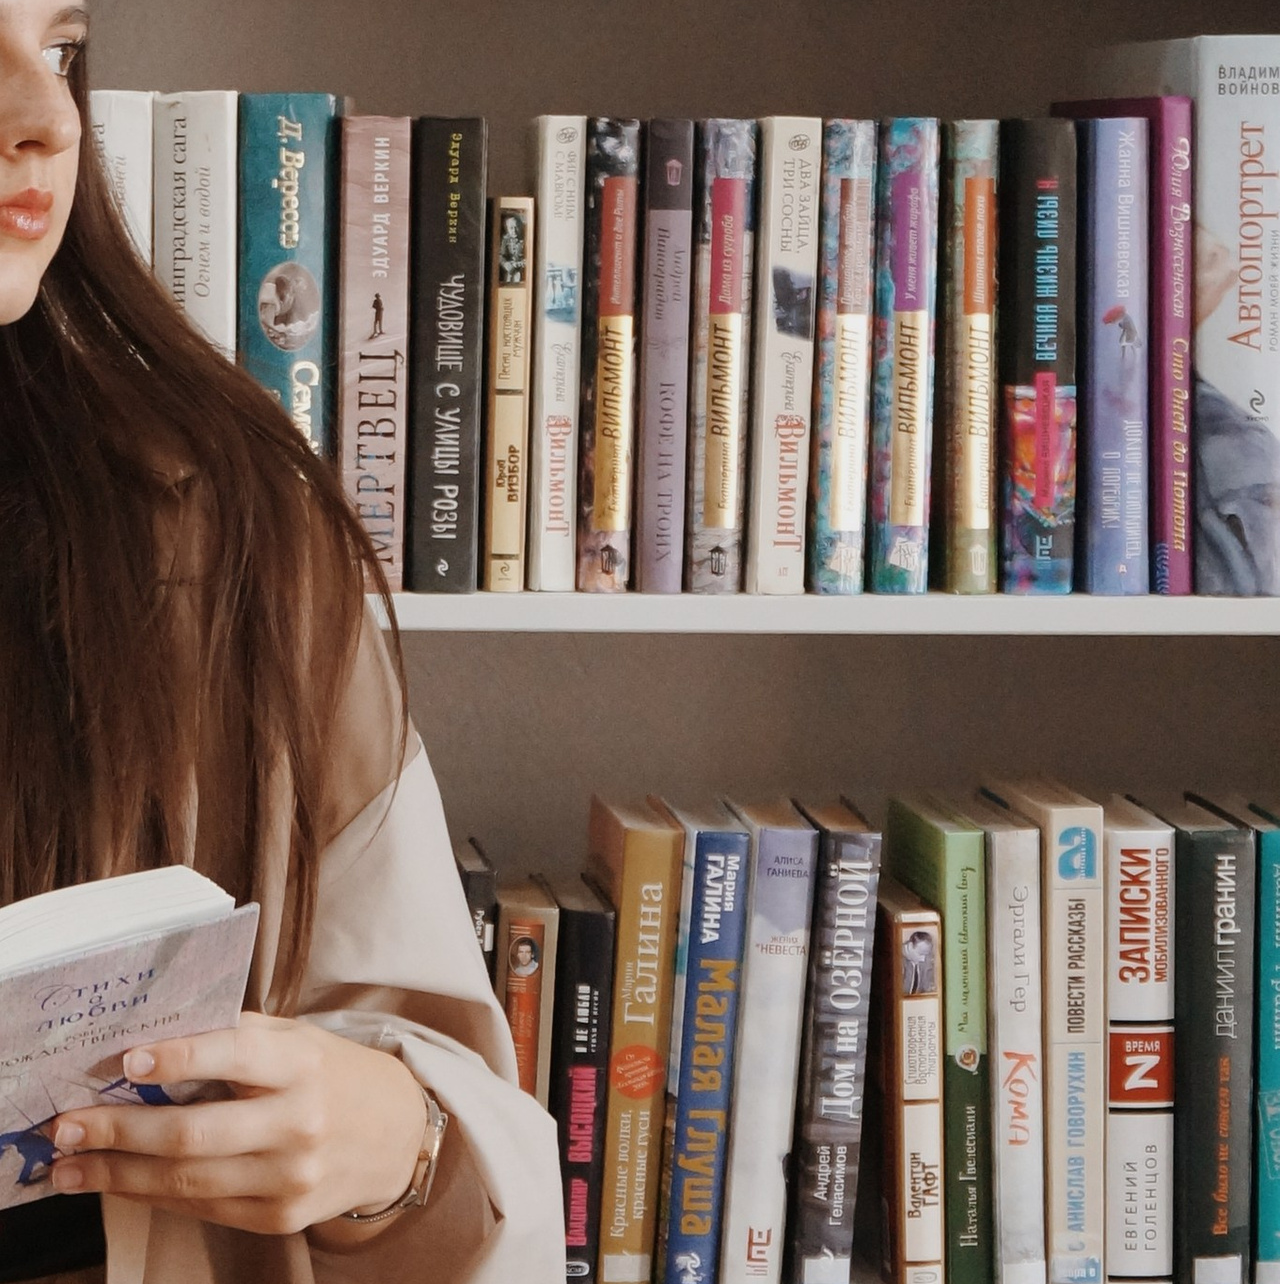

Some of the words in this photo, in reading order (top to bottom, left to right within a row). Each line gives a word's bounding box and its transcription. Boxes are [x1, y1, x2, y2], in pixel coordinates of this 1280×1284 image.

[374, 137, 390, 204] ВЕРКИН
[451, 133, 463, 186] Эдуард
[1118, 131, 1136, 189] Жанна
[1168, 137, 1190, 197] Юлия
[373, 213, 389, 278] ЭДУАРД
[448, 193, 461, 244] Веркин
[1116, 194, 1136, 300] Вишневская
[1171, 203, 1191, 318] Вознесенская
[437, 273, 465, 372] ЧУДОВИЩЕ
[437, 385, 459, 397] С
[709, 323, 732, 437] ВИЛЬМОНТ
[897, 321, 920, 435] ВИЛЬМОНТ
[356, 348, 404, 563] МЕРТВЕЦ
[433, 405, 461, 476] УЛИЦЫ
[507, 444, 520, 502] ВИЗБОР
[432, 484, 459, 541] РОЗЫ
[723, 855, 740, 912] Мария
[766, 868, 809, 879] ГАНИЕВА
[774, 855, 804, 866] АЛИСА
[701, 854, 725, 945] ГАЛИНА
[824, 857, 873, 1011] ОЗЁРНОЙ
[1009, 886, 1029, 966] Эргали
[1119, 848, 1152, 984] ЗАПИСКИ
[1155, 848, 1169, 983] МОБИЛИЗОВАННОГО
[623, 881, 663, 1026] Галина
[1067, 898, 1086, 971] РАССКАЗЫ
[691, 959, 735, 1092] Малая
[1011, 972, 1029, 1013] Гер
[1067, 976, 1085, 1034] ПОВЕСТИ
[832, 1020, 859, 1052] на
[1126, 1041, 1161, 1053] ВРЕМЯ
[821, 1058, 859, 1119] Дом
[677, 1110, 728, 1237] Глуша
[812, 1146, 830, 1201] Андрей
[829, 1146, 847, 1226] Геласимов
[922, 1162, 938, 1207] ГАФТ
[1124, 1160, 1139, 1252] ЕВГЕНИЙ
[1144, 1144, 1159, 1252] ГОЛЕНЦОВ
